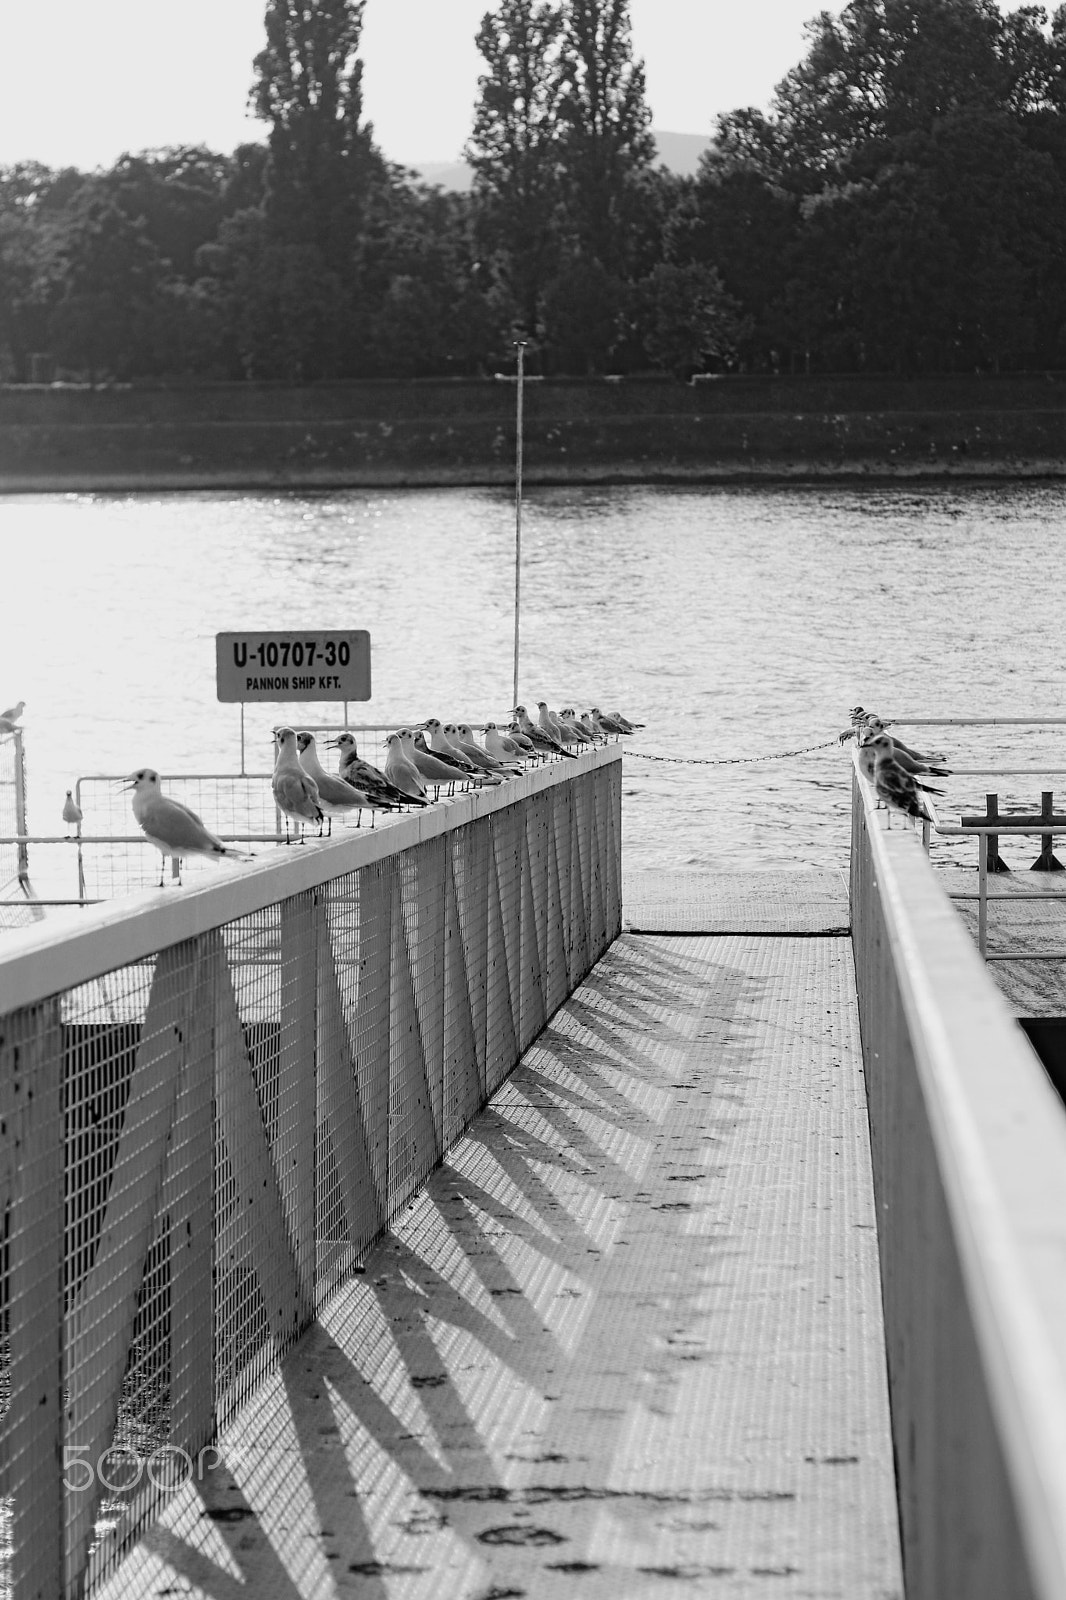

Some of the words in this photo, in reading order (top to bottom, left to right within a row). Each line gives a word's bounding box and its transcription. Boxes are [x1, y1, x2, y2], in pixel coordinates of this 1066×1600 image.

[233, 641, 350, 668] U-10707-30
[246, 677, 289, 690] PANNON
[292, 676, 316, 690] SHIP
[319, 676, 341, 689] KFT.
